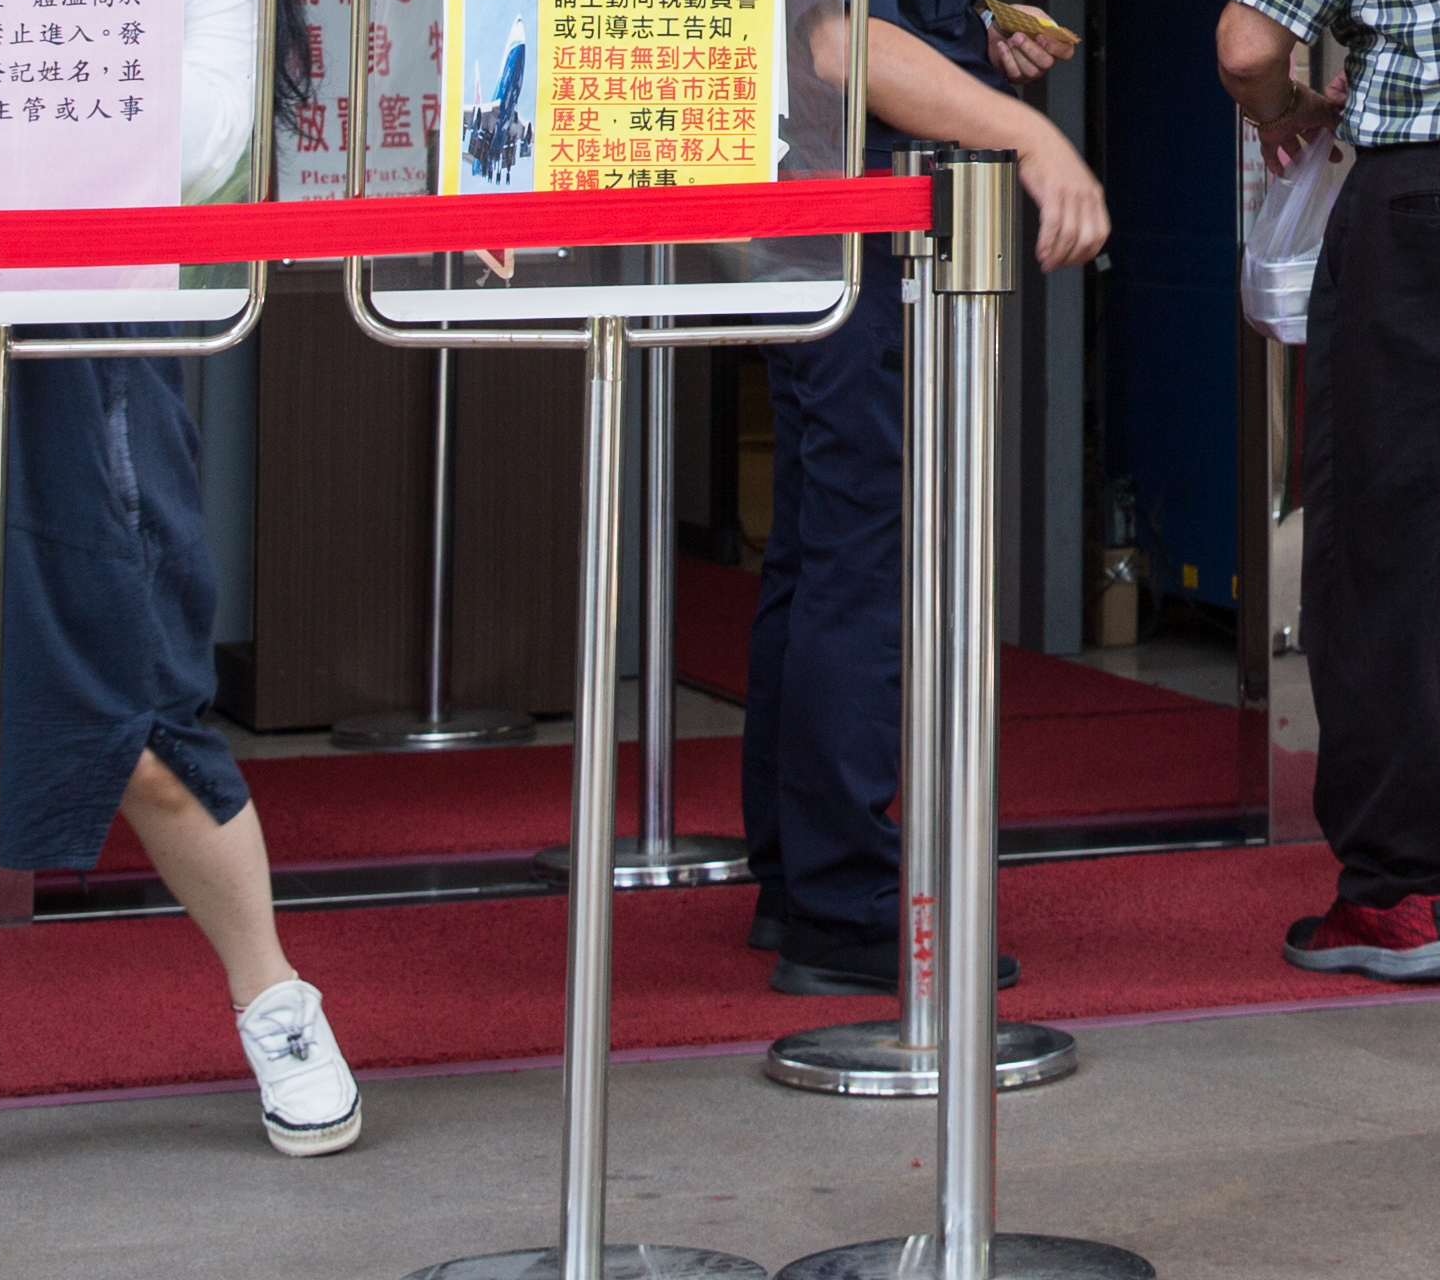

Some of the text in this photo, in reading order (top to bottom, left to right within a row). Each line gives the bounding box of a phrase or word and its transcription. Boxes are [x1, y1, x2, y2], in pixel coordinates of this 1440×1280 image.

[552, 45, 758, 70] 近期有無到大陸武
[551, 76, 757, 101] 漢及其他省市活動
[550, 138, 756, 162] 大陸地區商務人士
[301, 170, 347, 185] Pleas
